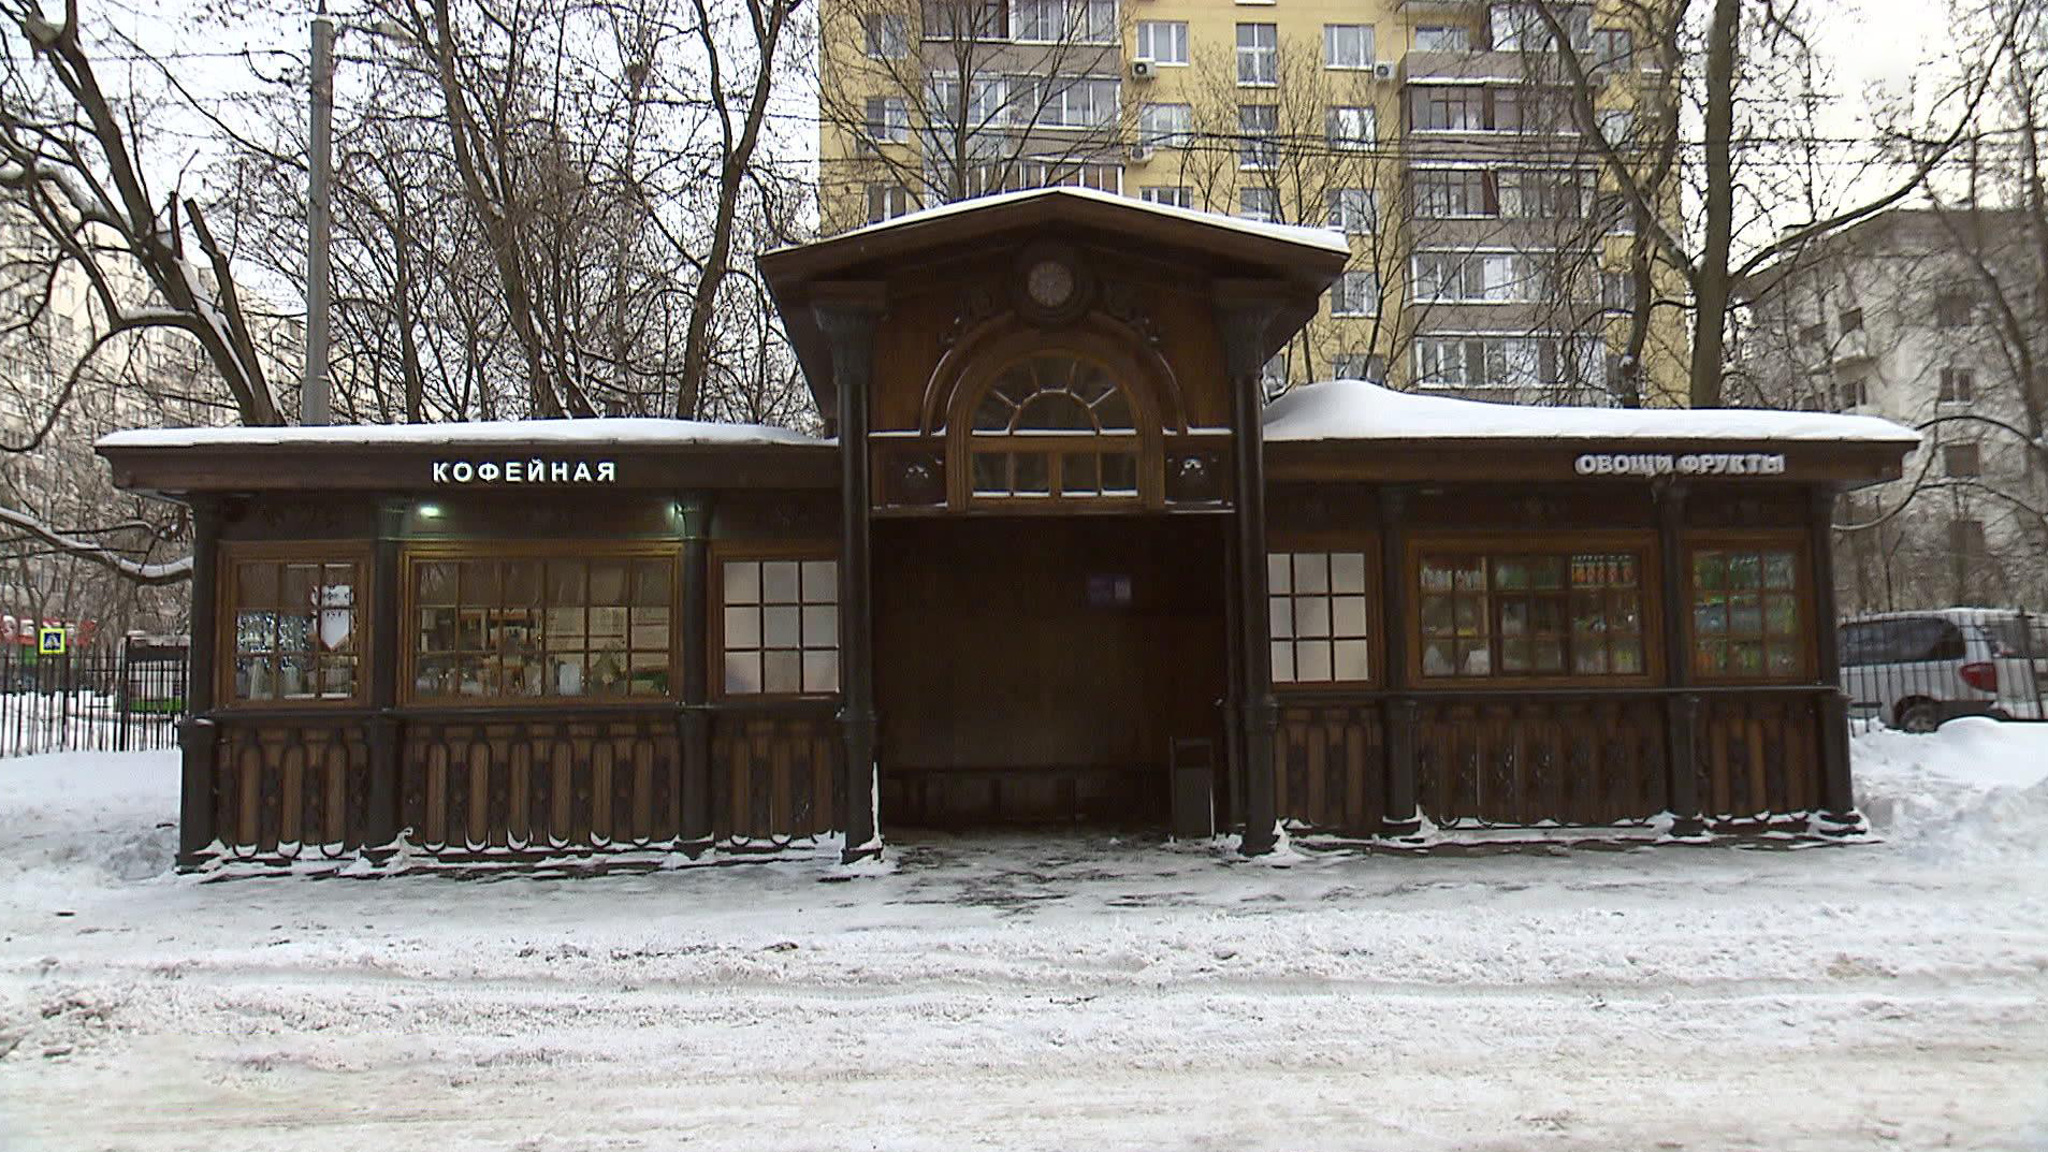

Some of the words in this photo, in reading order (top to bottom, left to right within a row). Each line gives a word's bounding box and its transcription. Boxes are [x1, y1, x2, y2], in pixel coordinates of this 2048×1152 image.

[432, 458, 616, 482] КОФЕЙНАЯ
[1575, 454, 1674, 476] ОВОЩИ
[1675, 453, 1786, 474] ФРУКТЫ
